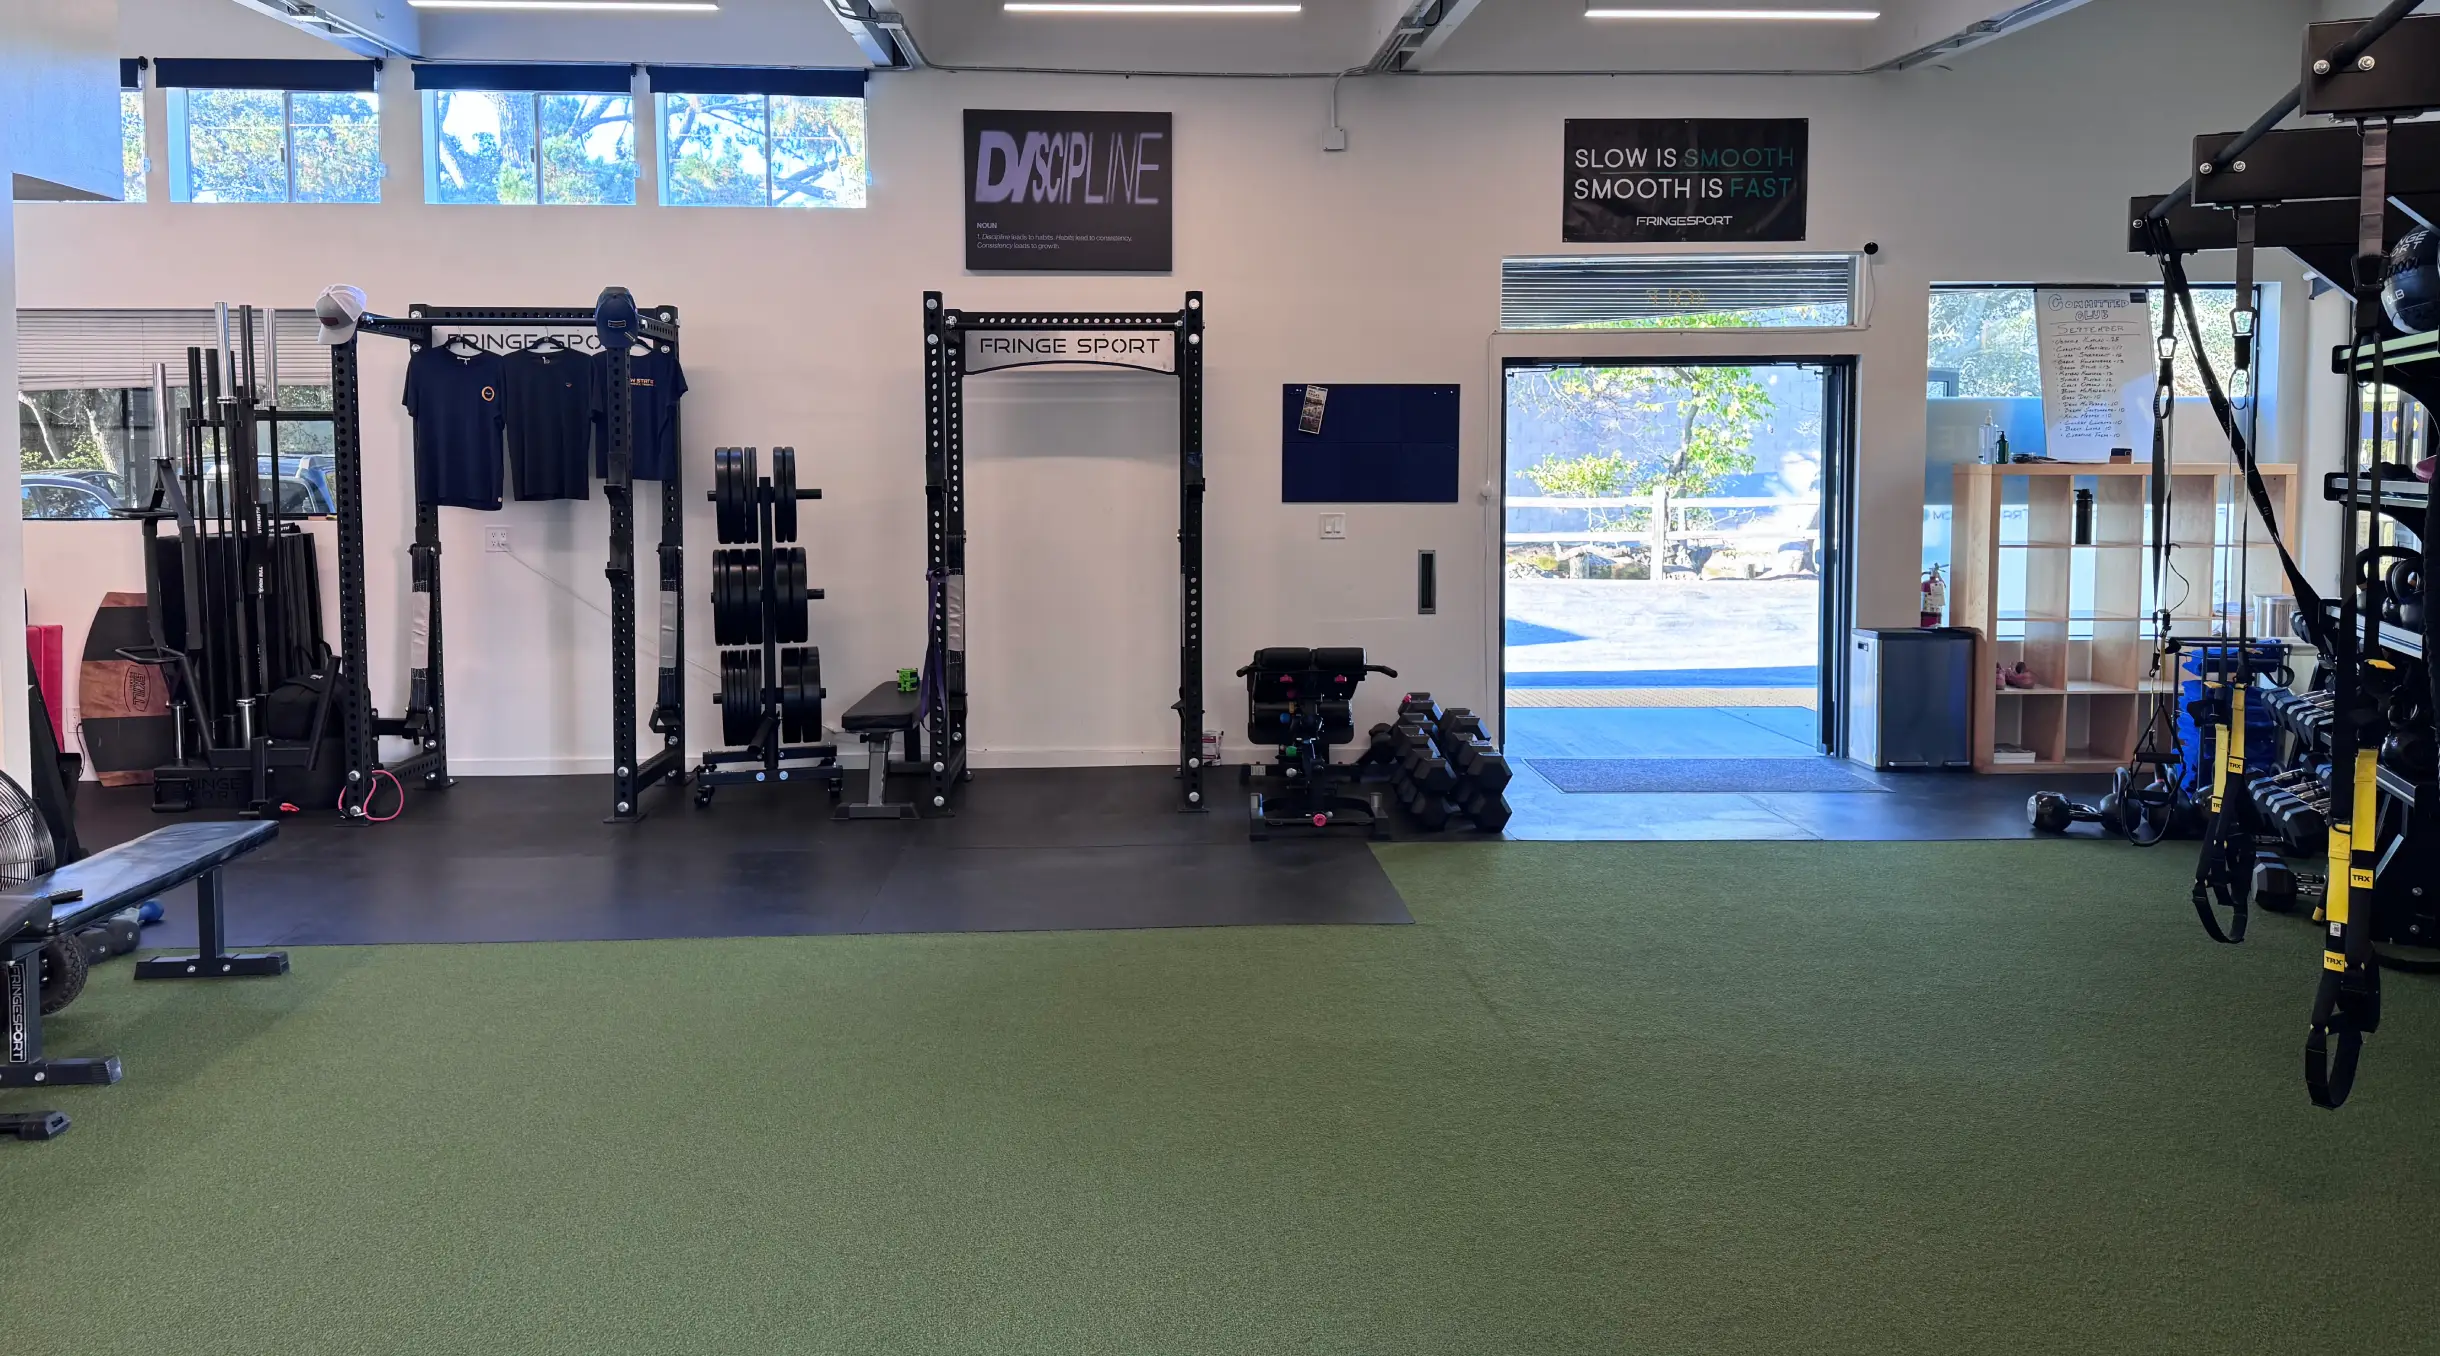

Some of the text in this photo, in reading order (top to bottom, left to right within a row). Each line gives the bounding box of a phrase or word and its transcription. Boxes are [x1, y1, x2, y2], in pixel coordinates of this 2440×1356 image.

[1575, 147, 1794, 168] SLOW IS SMOOTH
[975, 130, 1164, 205] DISCIPLINE
[1574, 177, 1792, 200] SMOOTH IS FAST
[1636, 216, 1733, 226] FRINGESPORT
[982, 233, 1010, 242] Discipline
[977, 241, 1013, 250] Consistency
[2075, 309, 2109, 321] CLUB
[448, 334, 538, 350] FRINGE
[980, 338, 1160, 354] FRINGE SPORT
[2352, 874, 2371, 883] TRX
[2325, 956, 2343, 965] TRX
[10, 966, 24, 1060] FRINGESPORT
